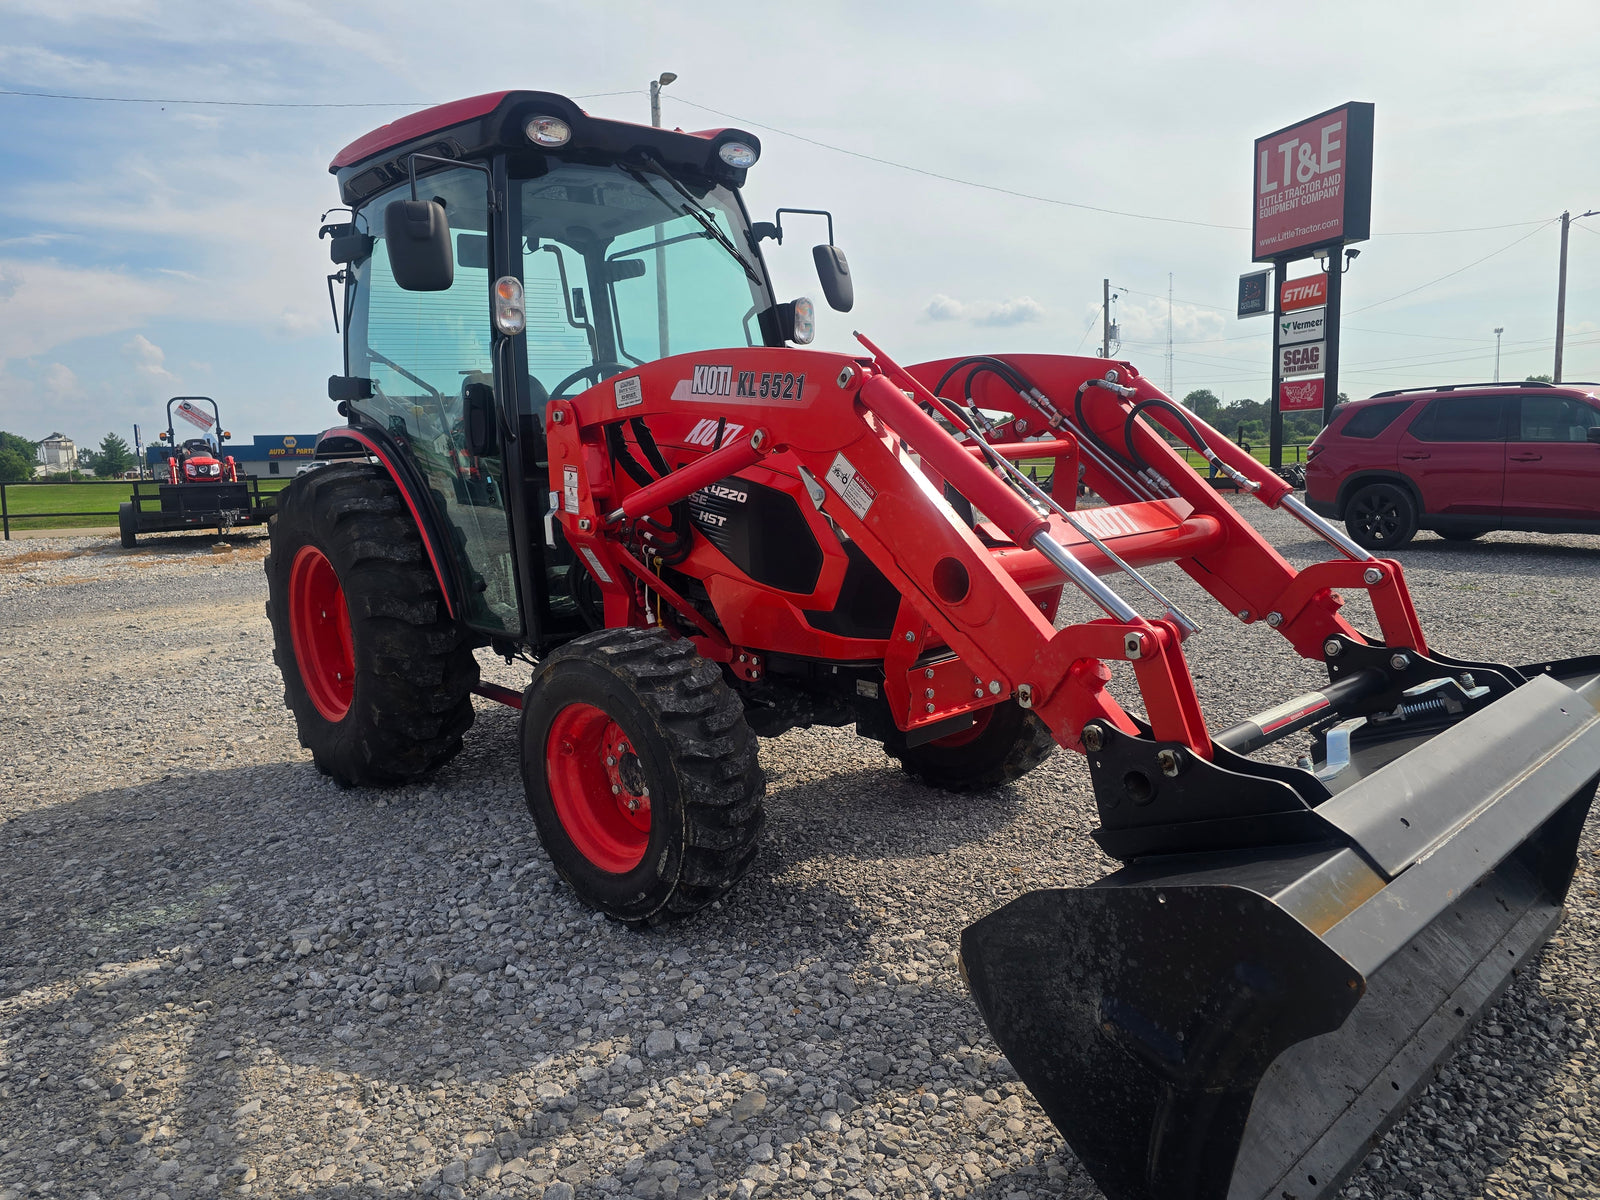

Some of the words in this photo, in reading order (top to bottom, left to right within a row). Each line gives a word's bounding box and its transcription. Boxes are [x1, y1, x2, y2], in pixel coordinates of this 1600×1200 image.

[1260, 121, 1342, 195] LT&E
[1259, 192, 1284, 209] LITTLE
[1285, 179, 1321, 199] TRACTOR
[1322, 173, 1341, 189] AND
[1259, 197, 1300, 219] EQUIPMENT
[1301, 185, 1340, 206] COMPANY
[1260, 218, 1339, 247] www.LittleTractor.com
[1283, 283, 1322, 303] STIHL
[1293, 319, 1323, 330] Vermeer
[1284, 346, 1320, 367] SCAG
[691, 364, 733, 396] KIOTI
[699, 511, 727, 527] HST
